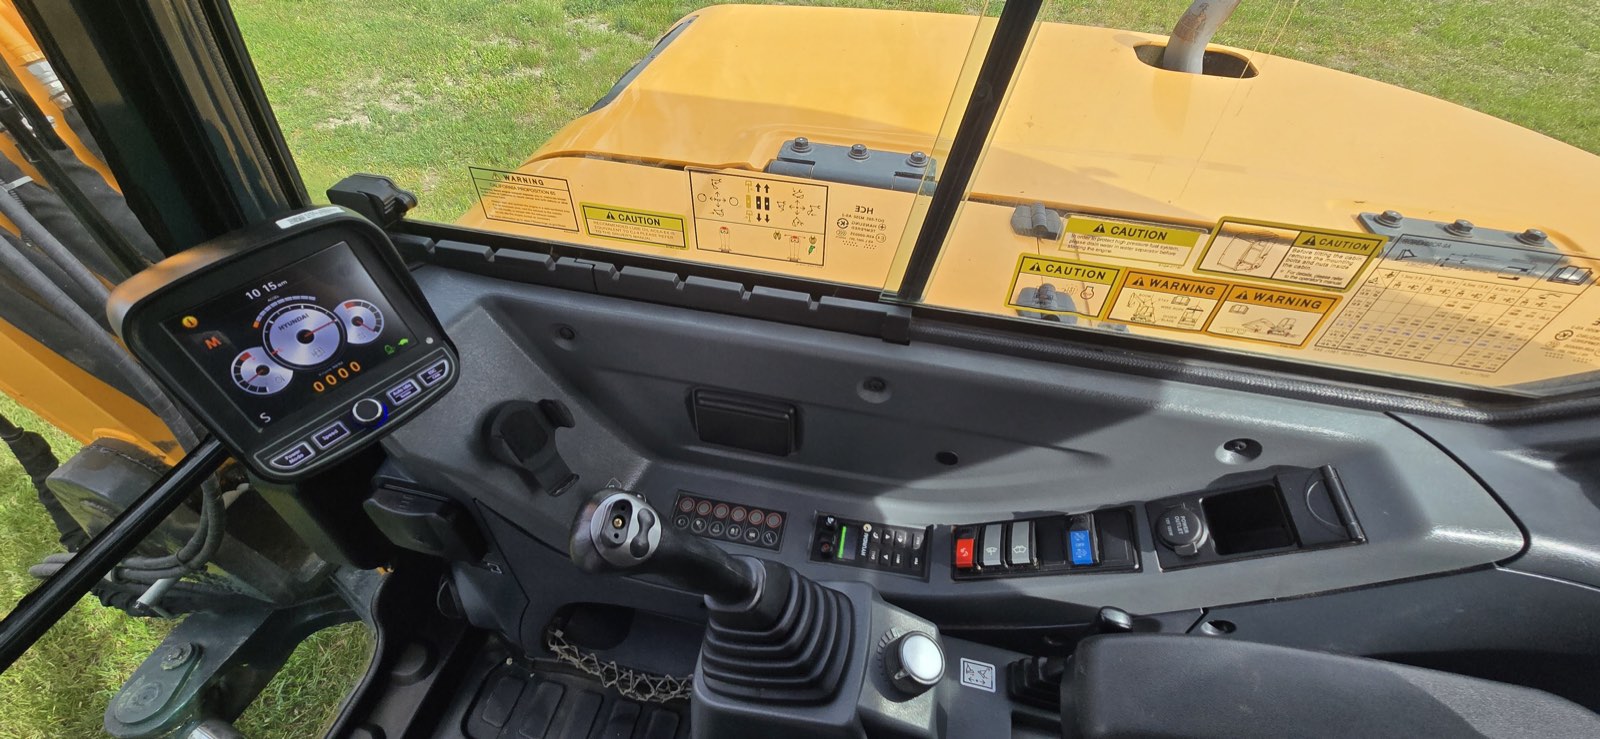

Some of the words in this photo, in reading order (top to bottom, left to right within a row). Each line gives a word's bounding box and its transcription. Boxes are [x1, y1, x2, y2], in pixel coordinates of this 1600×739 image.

[503, 174, 544, 186] WARNING
[518, 186, 549, 194] PROPOSITION
[618, 213, 661, 226] CAUTION
[1110, 226, 1168, 240] CAUTION
[1319, 238, 1370, 251] CAUTION
[1325, 258, 1354, 266] mounting
[1046, 264, 1106, 280] CAUTION
[245, 288, 261, 300] 10
[262, 281, 277, 293] 15
[1150, 279, 1215, 295] WARNING
[1254, 292, 1322, 309] WARNING
[278, 313, 310, 331] HYUNDAI
[204, 336, 222, 350] M
[260, 412, 271, 423] S
[322, 429, 338, 440] Speed
[284, 449, 300, 460] Power
[289, 453, 304, 464] Mode
[1174, 516, 1183, 534] OUTLET
[1180, 516, 1189, 534] POWER
[861, 532, 869, 556] HYUNDAI
